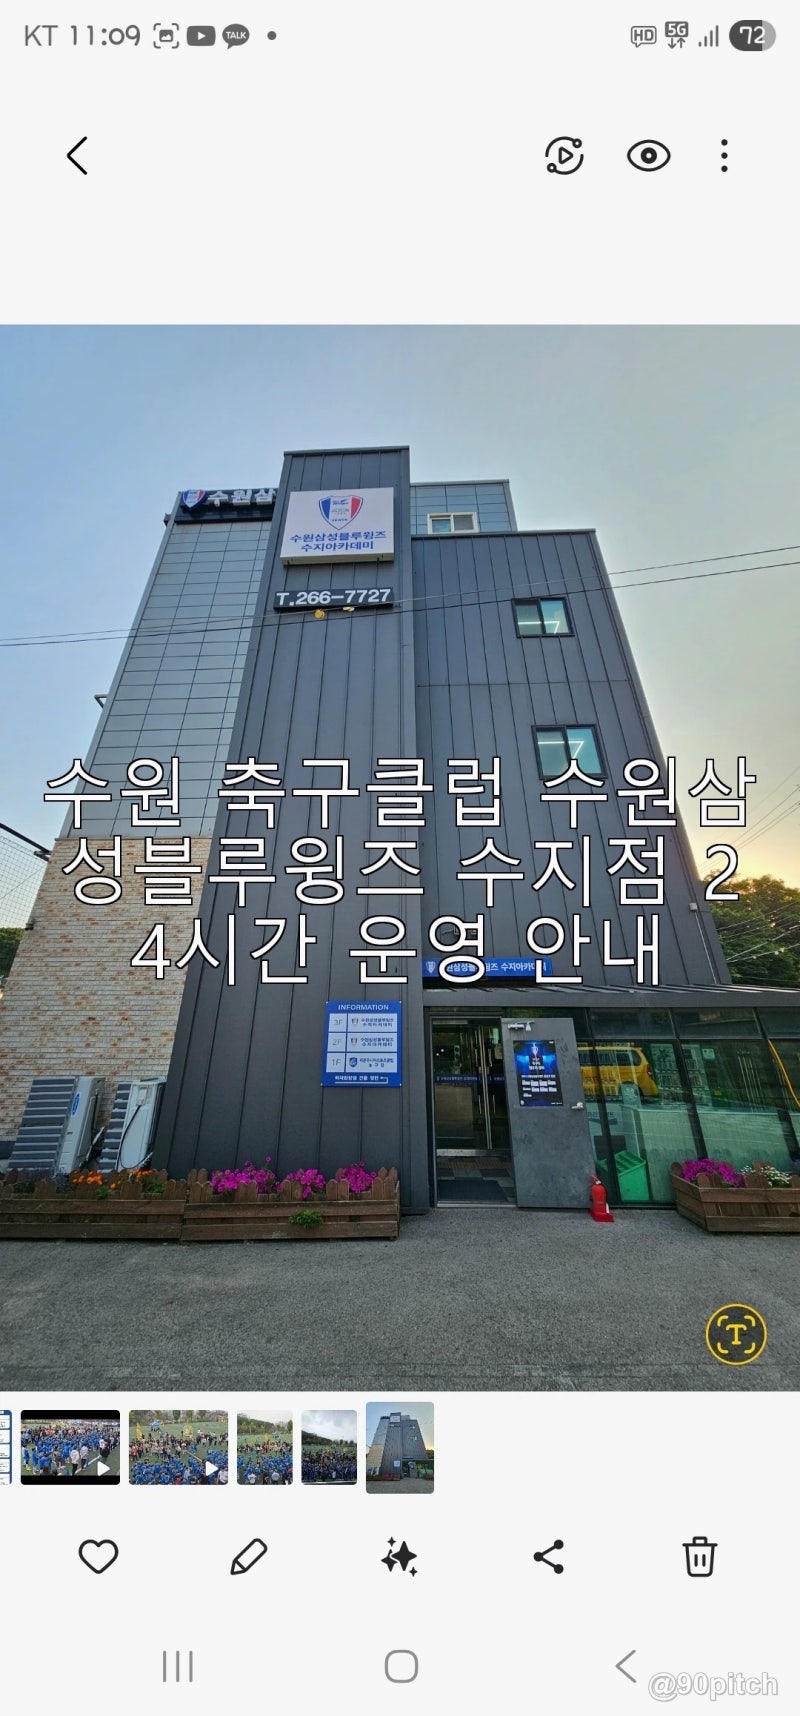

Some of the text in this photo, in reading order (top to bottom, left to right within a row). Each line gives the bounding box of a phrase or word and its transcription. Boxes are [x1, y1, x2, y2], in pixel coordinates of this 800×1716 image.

[24, 24, 141, 47] KT 11:09
[225, 31, 247, 40] TALK
[633, 29, 654, 42] HD
[667, 23, 687, 36] 5G
[739, 25, 766, 45] 72
[290, 531, 387, 543] 수원삼성블루윙즈
[301, 541, 374, 552] 수지아카데미
[276, 588, 391, 606] T.266-7727
